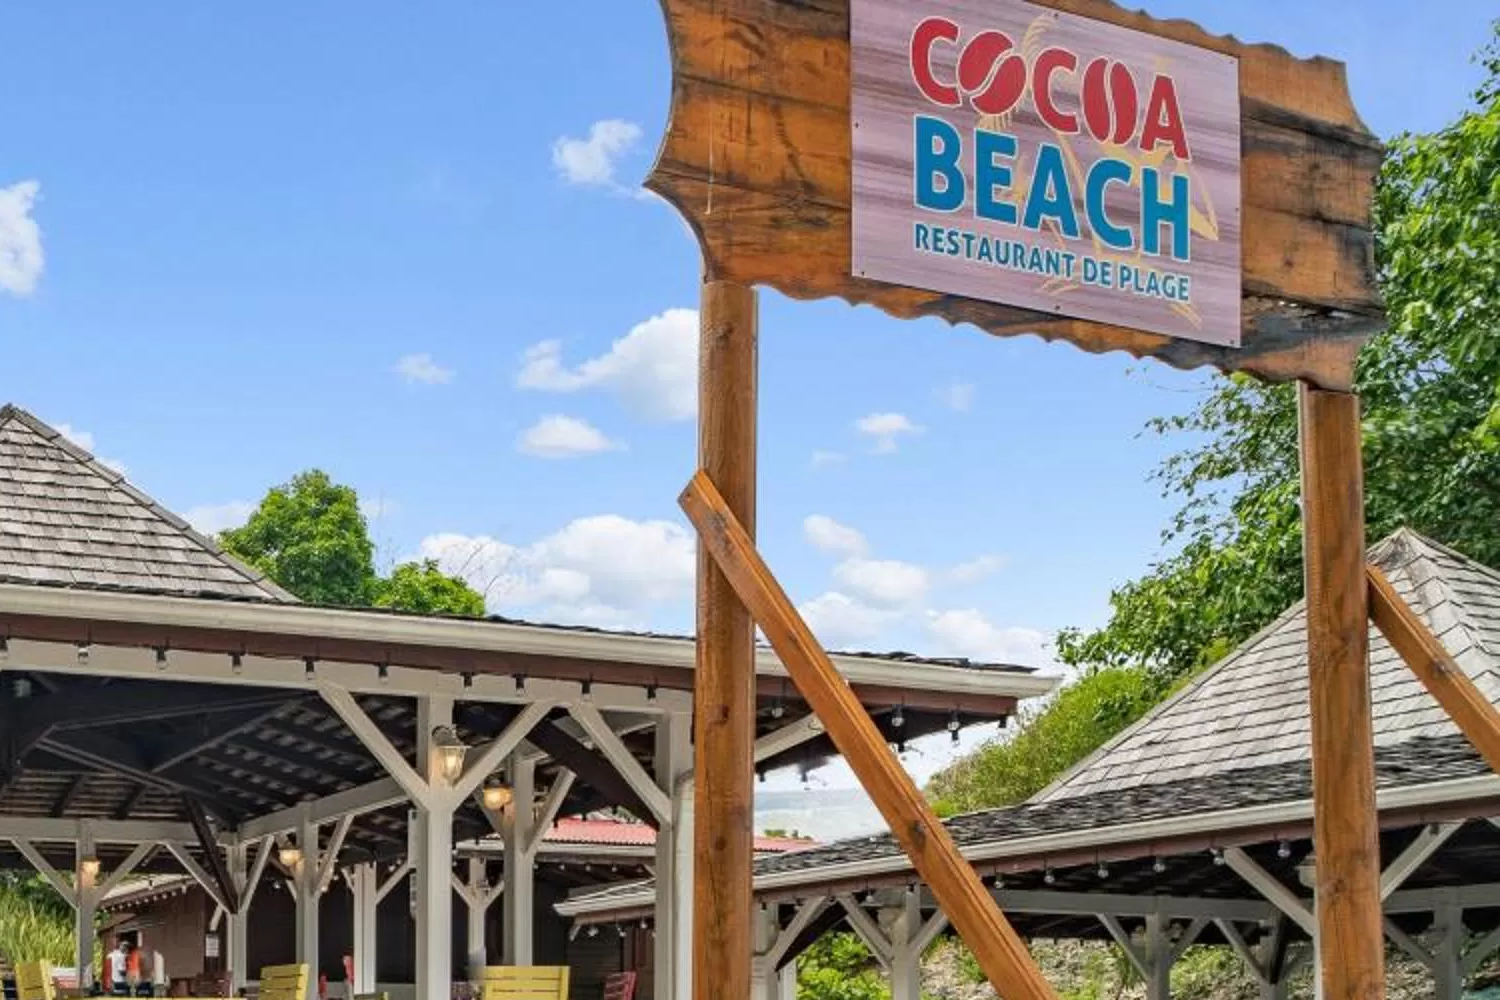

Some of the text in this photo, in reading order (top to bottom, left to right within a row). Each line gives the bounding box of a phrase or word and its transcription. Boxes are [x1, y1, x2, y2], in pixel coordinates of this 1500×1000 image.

[910, 16, 1190, 161] COCOA
[914, 114, 1190, 262] BEACH
[914, 222, 1189, 300] RESTAURANT DE PLAGE
